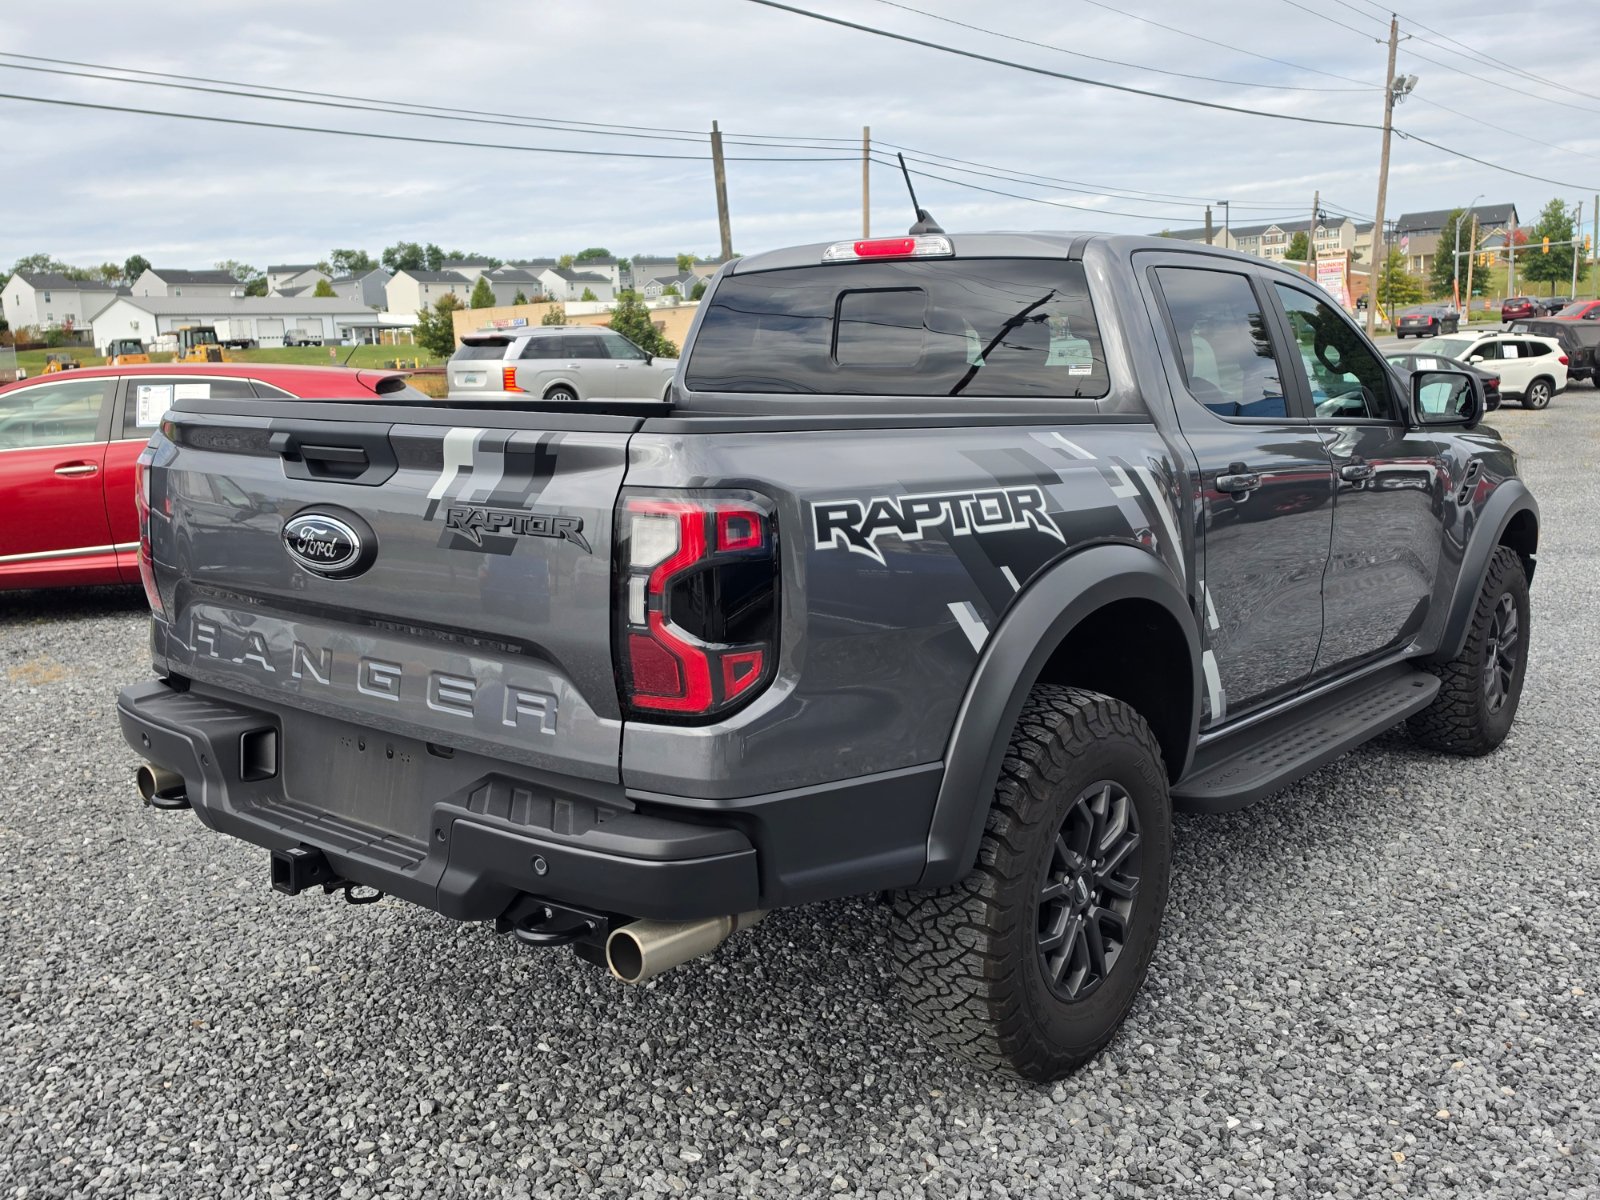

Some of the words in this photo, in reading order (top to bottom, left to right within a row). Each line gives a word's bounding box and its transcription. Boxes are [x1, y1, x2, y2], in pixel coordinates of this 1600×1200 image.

[297, 525, 337, 558] Ford
[446, 505, 593, 555] RAPTOR
[811, 485, 1067, 567] RAPTOR
[189, 617, 559, 736] RANGER
